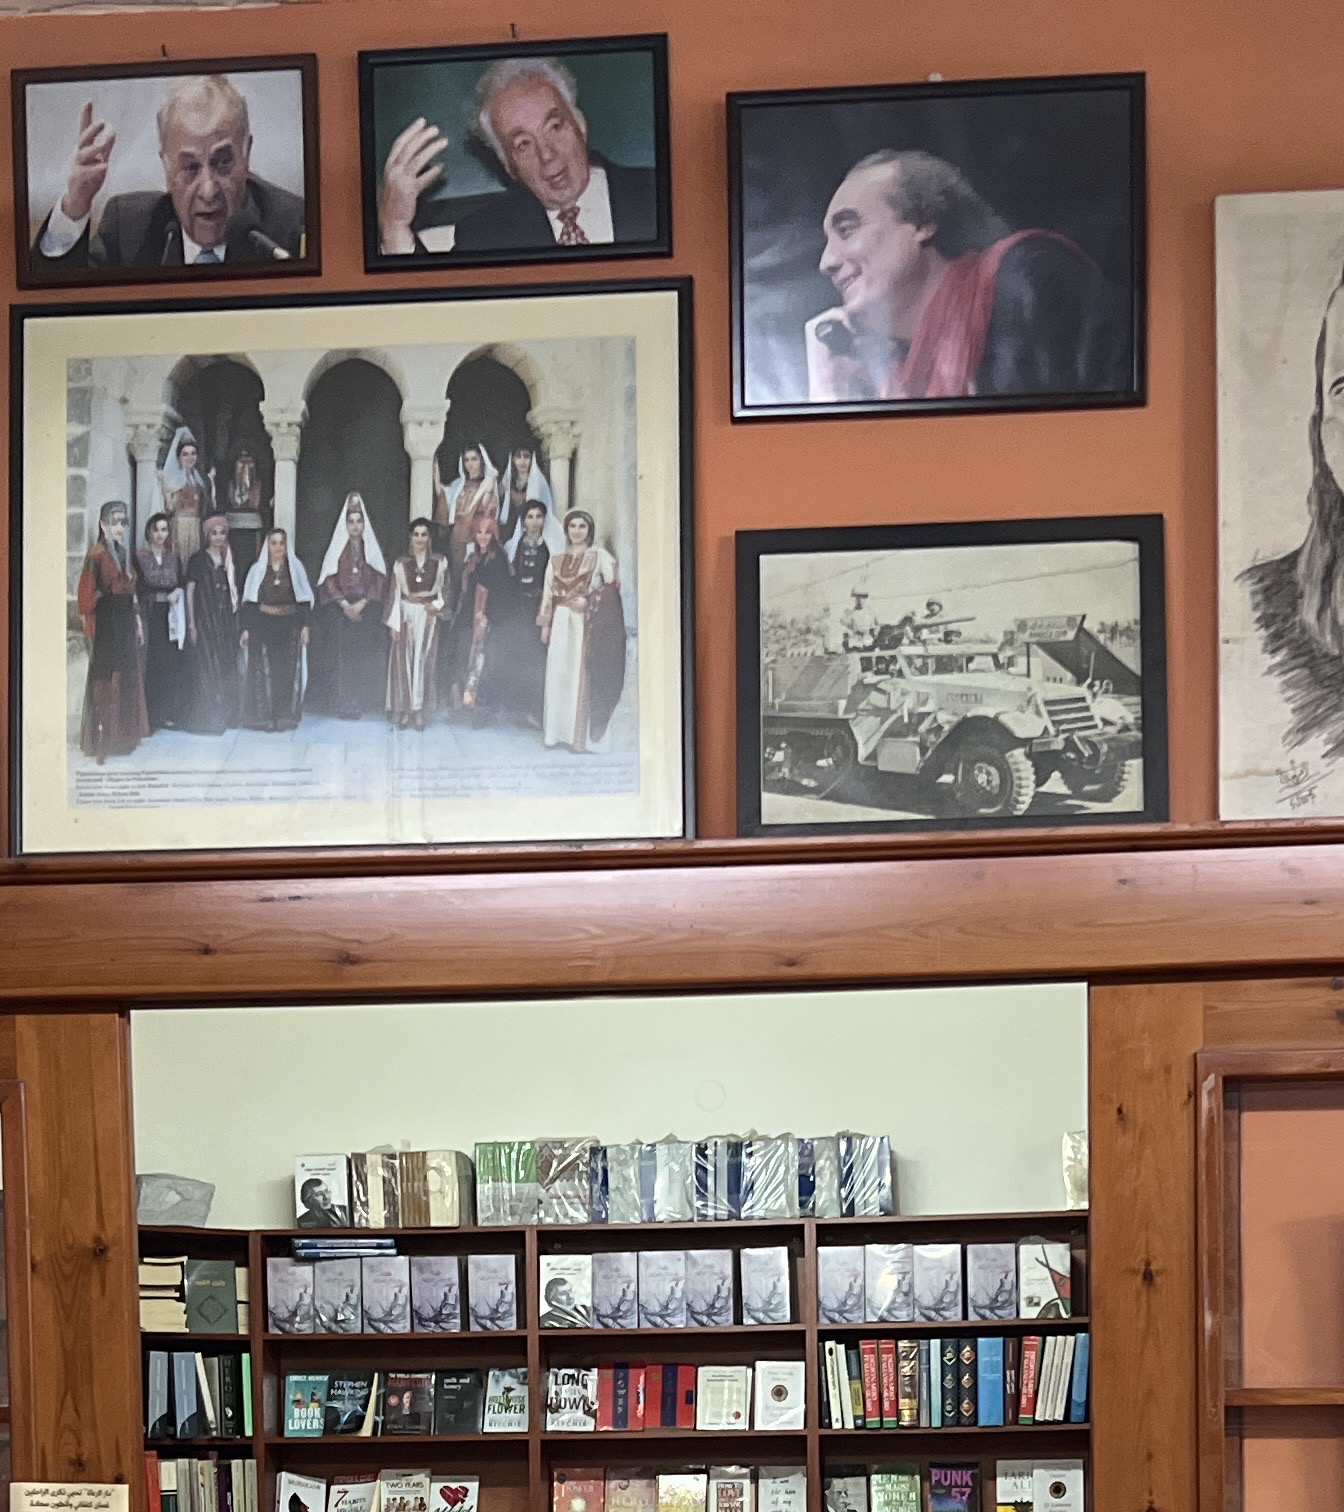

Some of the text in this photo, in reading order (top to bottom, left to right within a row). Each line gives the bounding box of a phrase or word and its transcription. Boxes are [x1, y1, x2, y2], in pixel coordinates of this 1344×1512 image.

[333, 1380, 367, 1389] STEPHEN
[553, 1373, 588, 1388] LONG
[330, 1388, 369, 1396] HAWKING
[443, 1383, 462, 1391] honey
[293, 1407, 322, 1419] BOOK
[487, 1404, 526, 1415] FLOWER
[288, 1418, 325, 1430] LOVERS
[930, 1469, 974, 1486] PUNK
[334, 1489, 349, 1508] 7
[950, 1487, 971, 1503] 57
